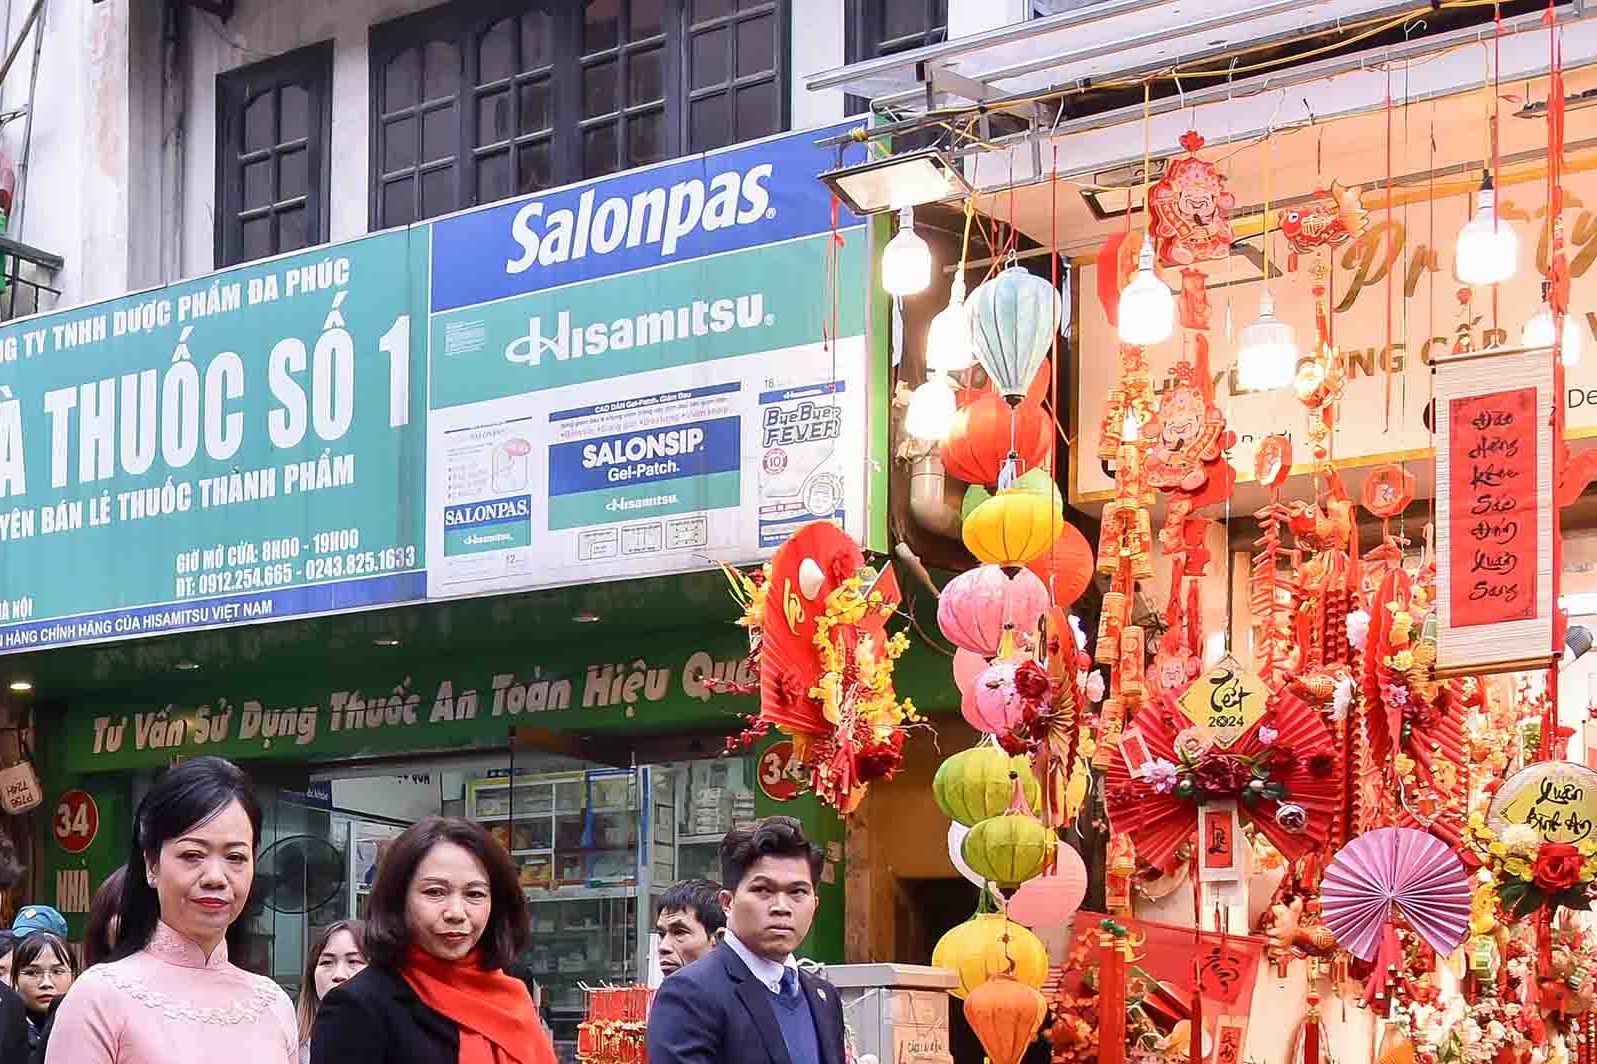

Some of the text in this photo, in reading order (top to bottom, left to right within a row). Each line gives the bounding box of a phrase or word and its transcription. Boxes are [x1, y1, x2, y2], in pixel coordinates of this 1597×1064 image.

[506, 164, 773, 274] Salonpas
[23, 333, 46, 357] TY
[52, 315, 106, 351] TNHH
[113, 299, 172, 337] DƯỢC
[178, 280, 241, 322] PHẨM
[248, 275, 278, 305] ĐA
[286, 258, 350, 296] PHÚC
[505, 293, 763, 366] Hisamitsu
[45, 326, 245, 488] THUỐC
[268, 290, 355, 449] SỐ
[378, 315, 411, 428] 1
[582, 428, 704, 468] SALONSIP
[41, 498, 83, 534] BÁN
[89, 489, 111, 526] LẺ
[117, 477, 191, 521] THUỐC
[199, 465, 276, 507] THÀNH
[284, 448, 355, 494] PHẨM
[262, 537, 300, 561] 8H00
[313, 528, 359, 554] 19H00
[199, 564, 292, 595] 0912.254.665
[306, 545, 415, 580] 0243.825.1633
[40, 622, 76, 642] CHÍNH
[143, 606, 209, 629] HISAMITSU
[211, 603, 239, 622] VIỆT
[243, 599, 272, 616] NAM
[93, 716, 128, 753] Tư
[134, 704, 188, 750] Vấn
[193, 697, 233, 744] Sử
[239, 700, 318, 748] Dụng
[330, 674, 421, 731] Thuốc
[429, 680, 477, 722] An
[491, 665, 571, 717] Toàn
[582, 658, 669, 718] Hiệu
[1210, 668, 1253, 712] Tết
[1208, 715, 1244, 727] 2024
[1536, 776, 1583, 805] Xuân
[56, 803, 89, 838] 34
